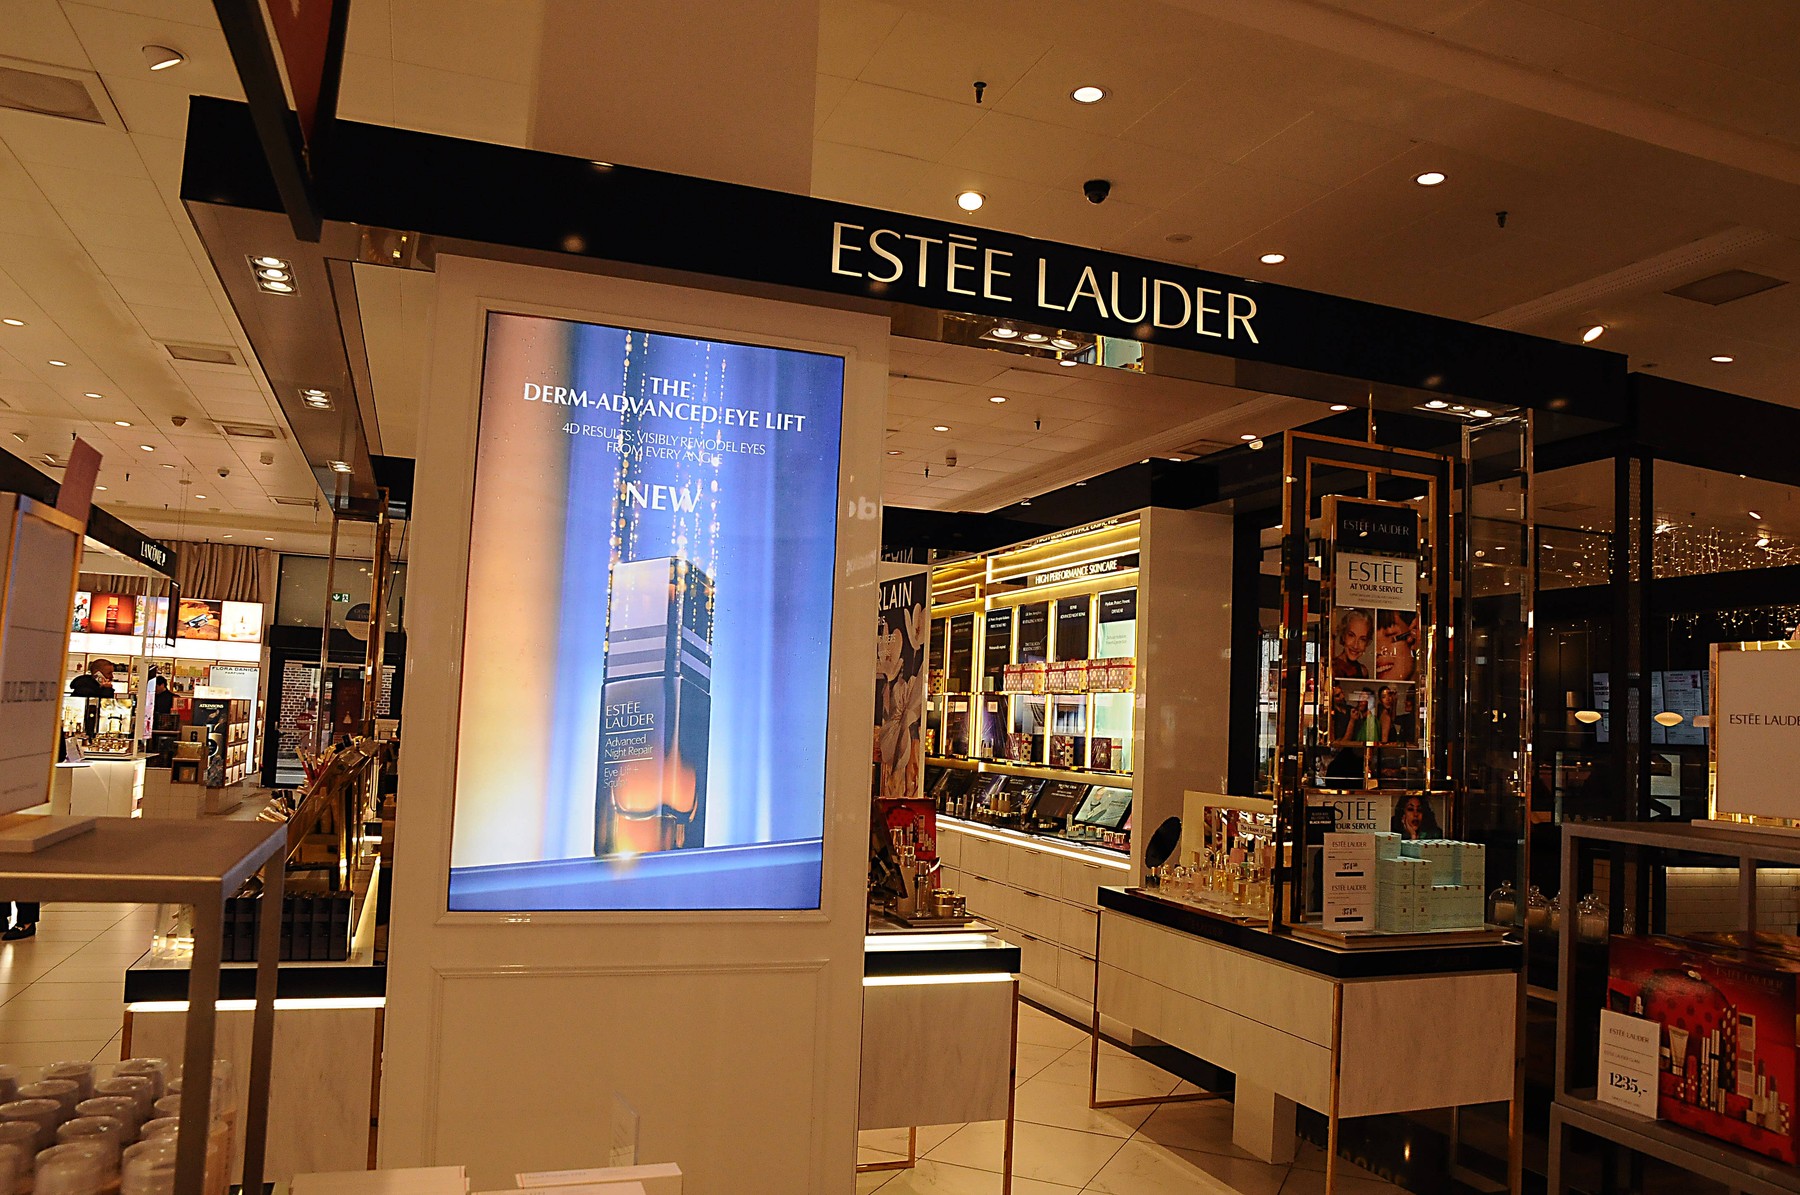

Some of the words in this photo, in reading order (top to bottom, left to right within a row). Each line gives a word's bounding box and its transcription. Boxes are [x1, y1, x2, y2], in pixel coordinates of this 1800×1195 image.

[1037, 258, 1259, 344] LAUDER
[650, 376, 691, 398] THE
[523, 382, 718, 423] DERM-ADVANCED
[725, 408, 760, 427] EYE
[766, 412, 806, 432] LIFT
[562, 422, 580, 435] 4D
[583, 426, 635, 442] RESULTS:
[637, 431, 679, 446] VISIBLY
[680, 436, 737, 453] REMODEL
[740, 443, 766, 455] EYES
[606, 441, 643, 455] FROM
[646, 447, 681, 460] EVERY
[682, 451, 722, 465] ANGLE
[624, 482, 703, 513] NEW
[1373, 523, 1409, 536] LAUDER
[1035, 574, 1049, 585] HIGH
[1050, 565, 1088, 582] PERFORMANCE
[1089, 559, 1118, 574] SKINCARE
[1359, 584, 1377, 592] YOUR
[1379, 585, 1403, 593] SERVICE
[605, 713, 655, 729] LAUDER
[605, 733, 647, 748] Advanced
[605, 747, 627, 760] Night
[628, 744, 653, 757] Repair
[604, 767, 618, 778] Eye
[1352, 822, 1377, 830] SERVICE
[1626, 1032, 1650, 1044] LAUDER
[1609, 1072, 1648, 1097] 1235,-
